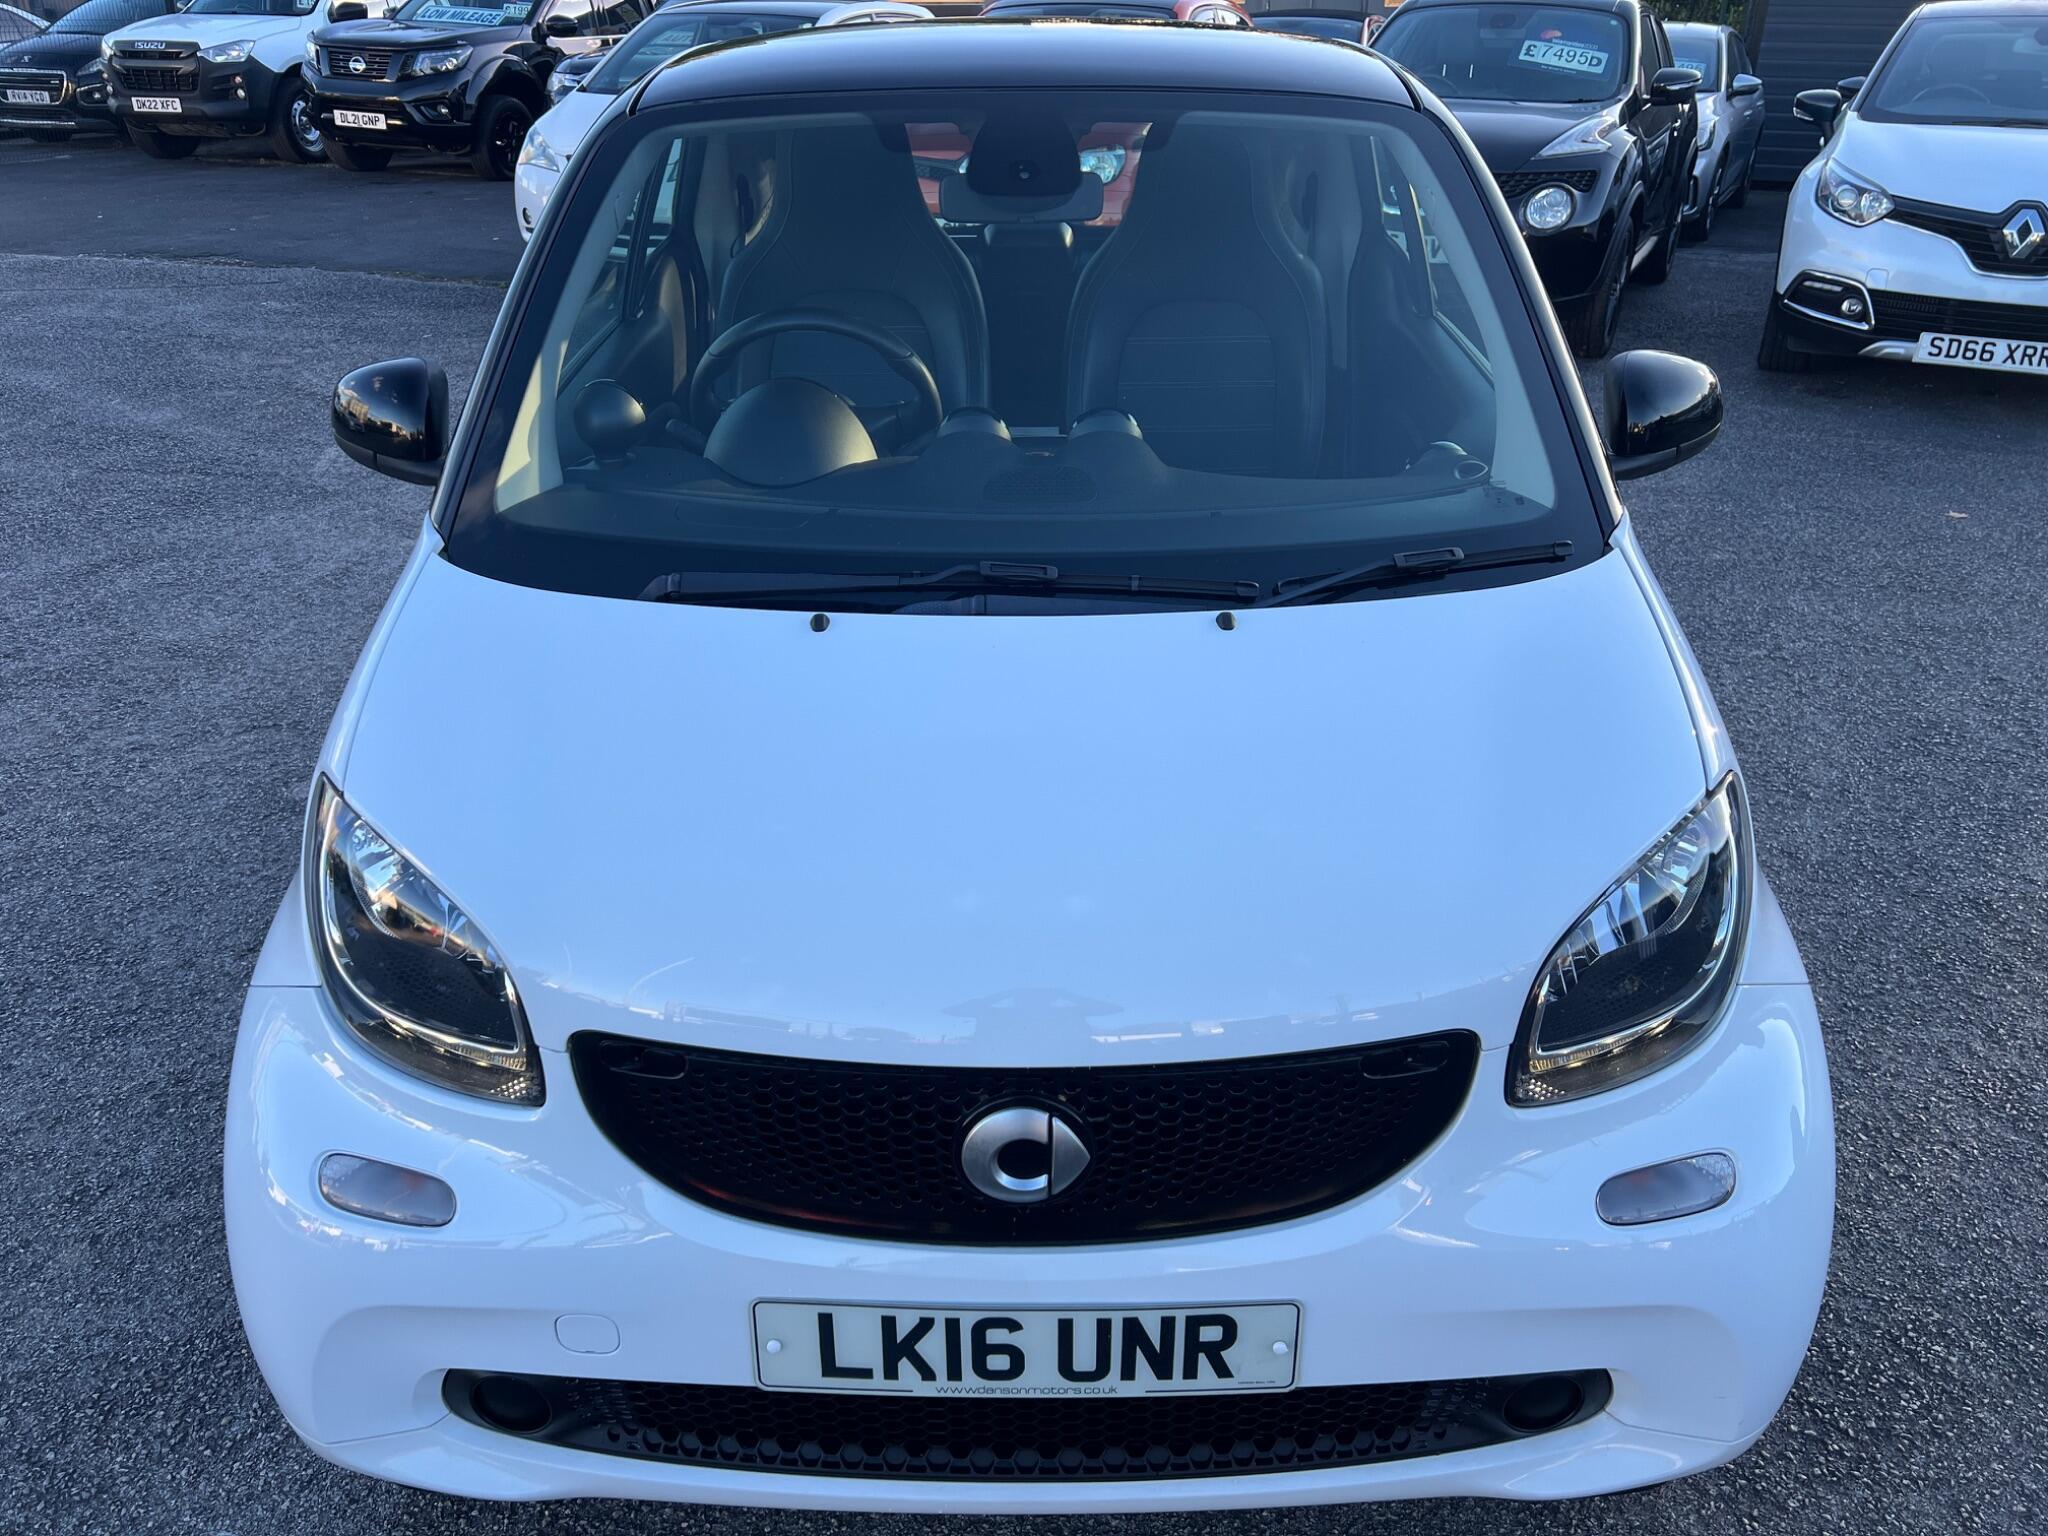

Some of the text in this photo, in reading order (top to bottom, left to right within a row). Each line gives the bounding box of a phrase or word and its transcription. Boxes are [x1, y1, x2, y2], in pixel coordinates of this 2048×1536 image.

[421, 8, 500, 24] LOW MILEAGE
[134, 41, 166, 49] ISUZU
[136, 99, 178, 110] DK22 XFC
[340, 112, 380, 126] DL21 GNP
[1927, 336, 1997, 362] SD66
[817, 1311, 1238, 1382] LK16 UNR
